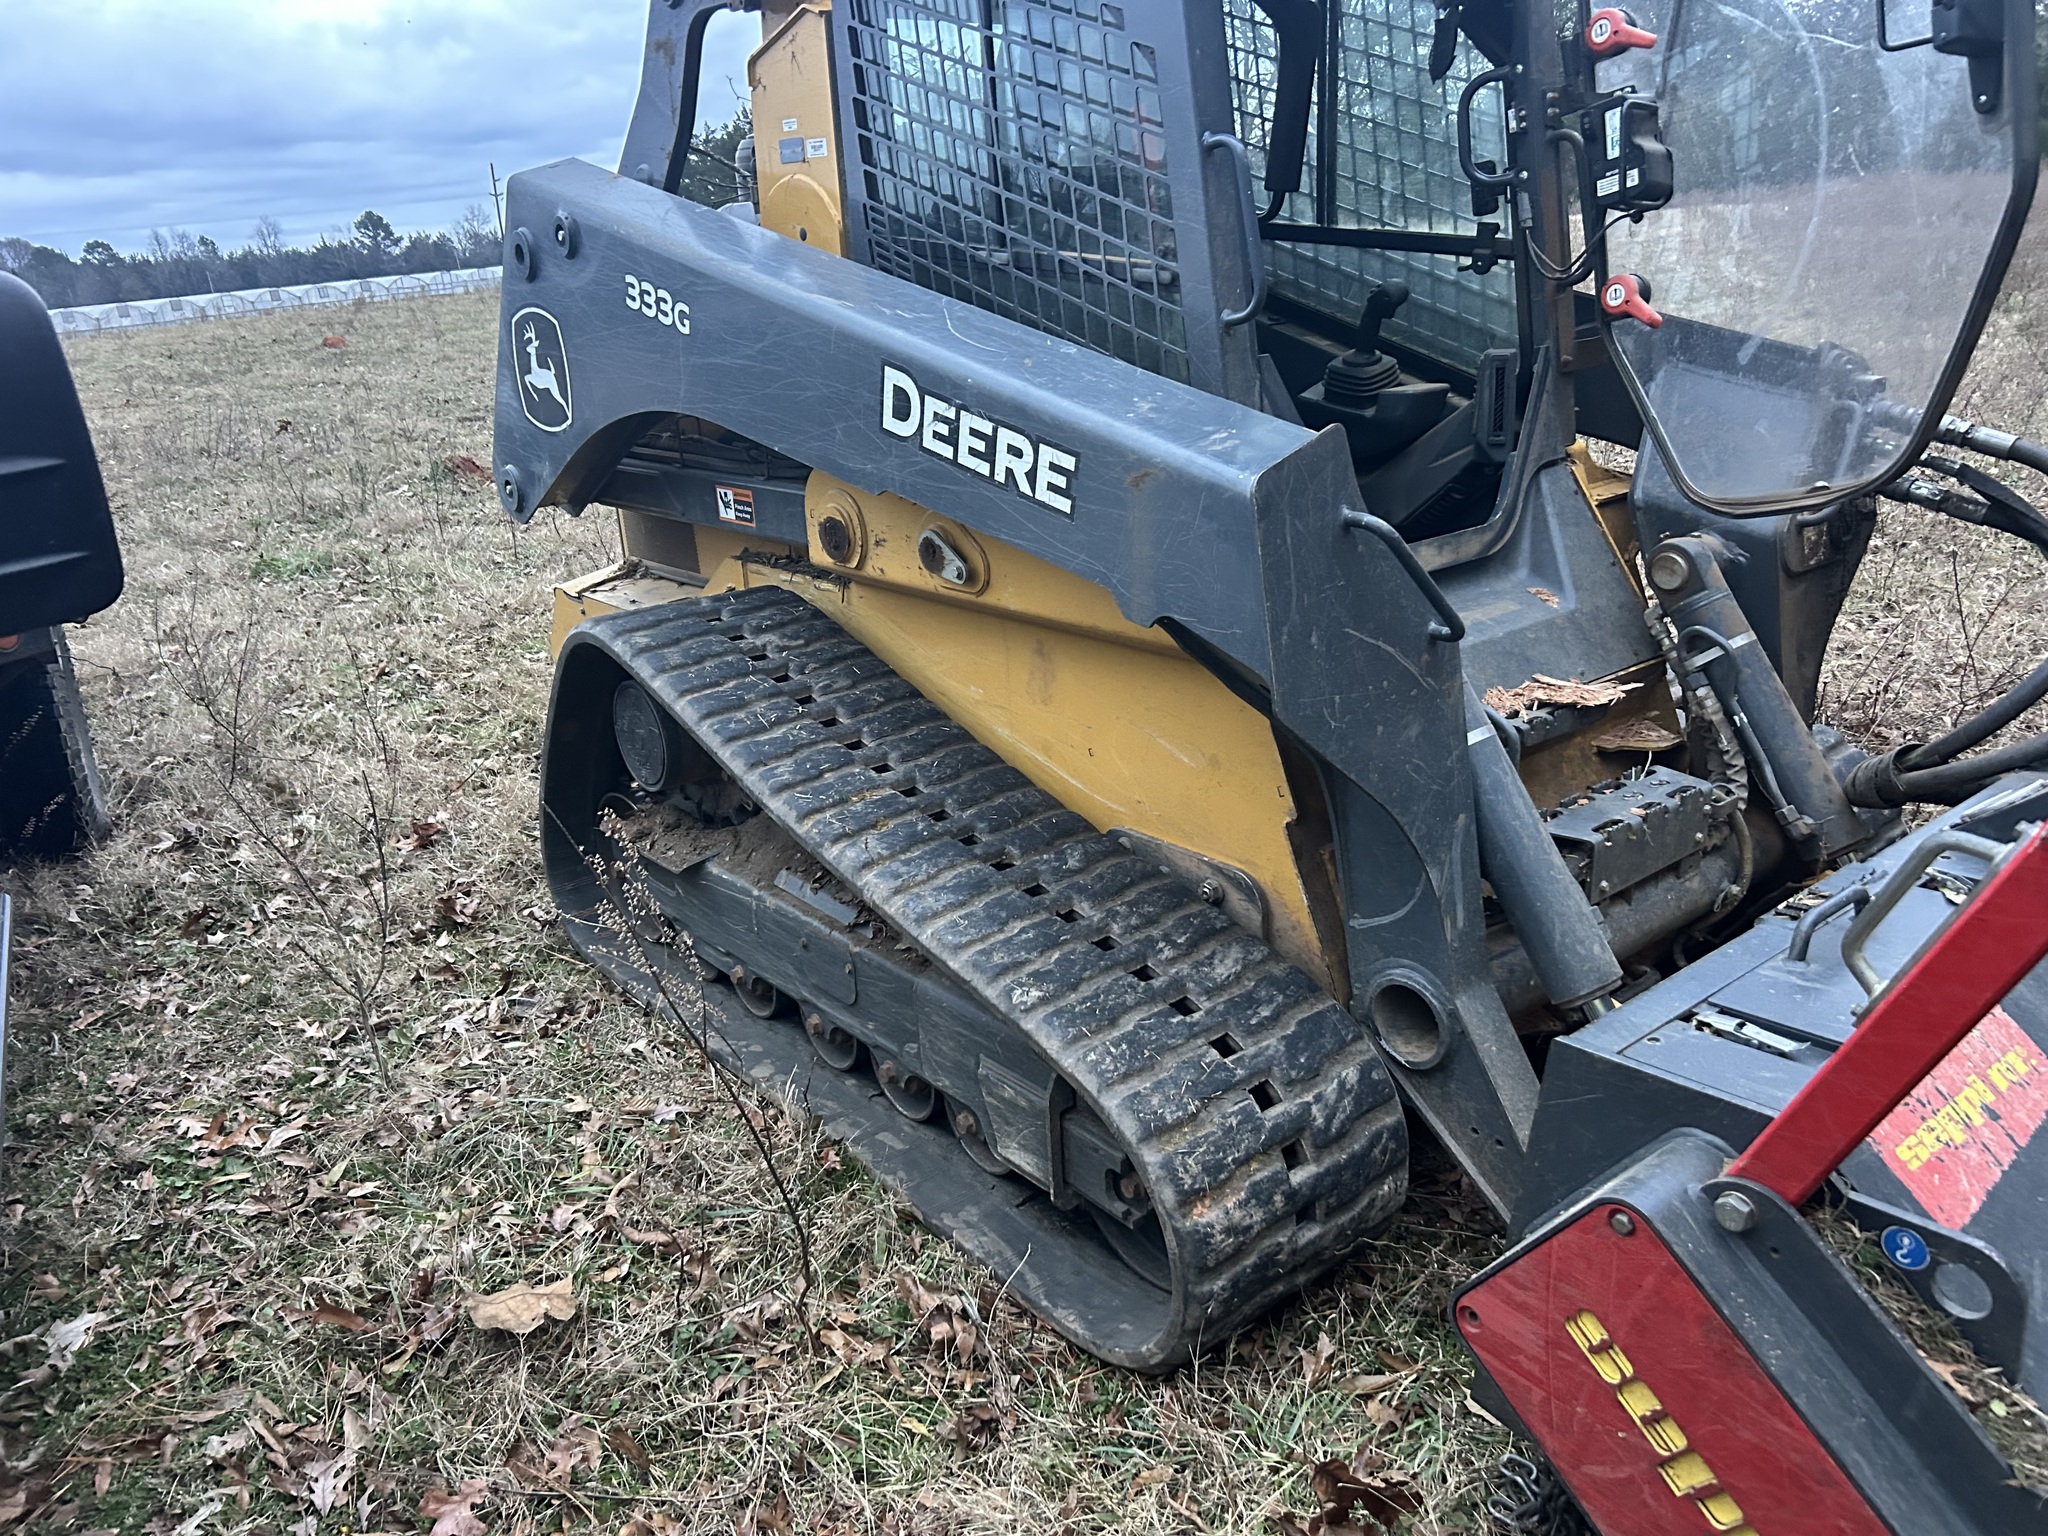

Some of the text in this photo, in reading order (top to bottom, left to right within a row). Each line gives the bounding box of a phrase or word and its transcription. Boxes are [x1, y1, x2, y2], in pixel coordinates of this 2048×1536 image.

[624, 273, 691, 335] 333G
[882, 365, 1076, 514] DEERE
[1564, 1308, 1759, 1536] sep
